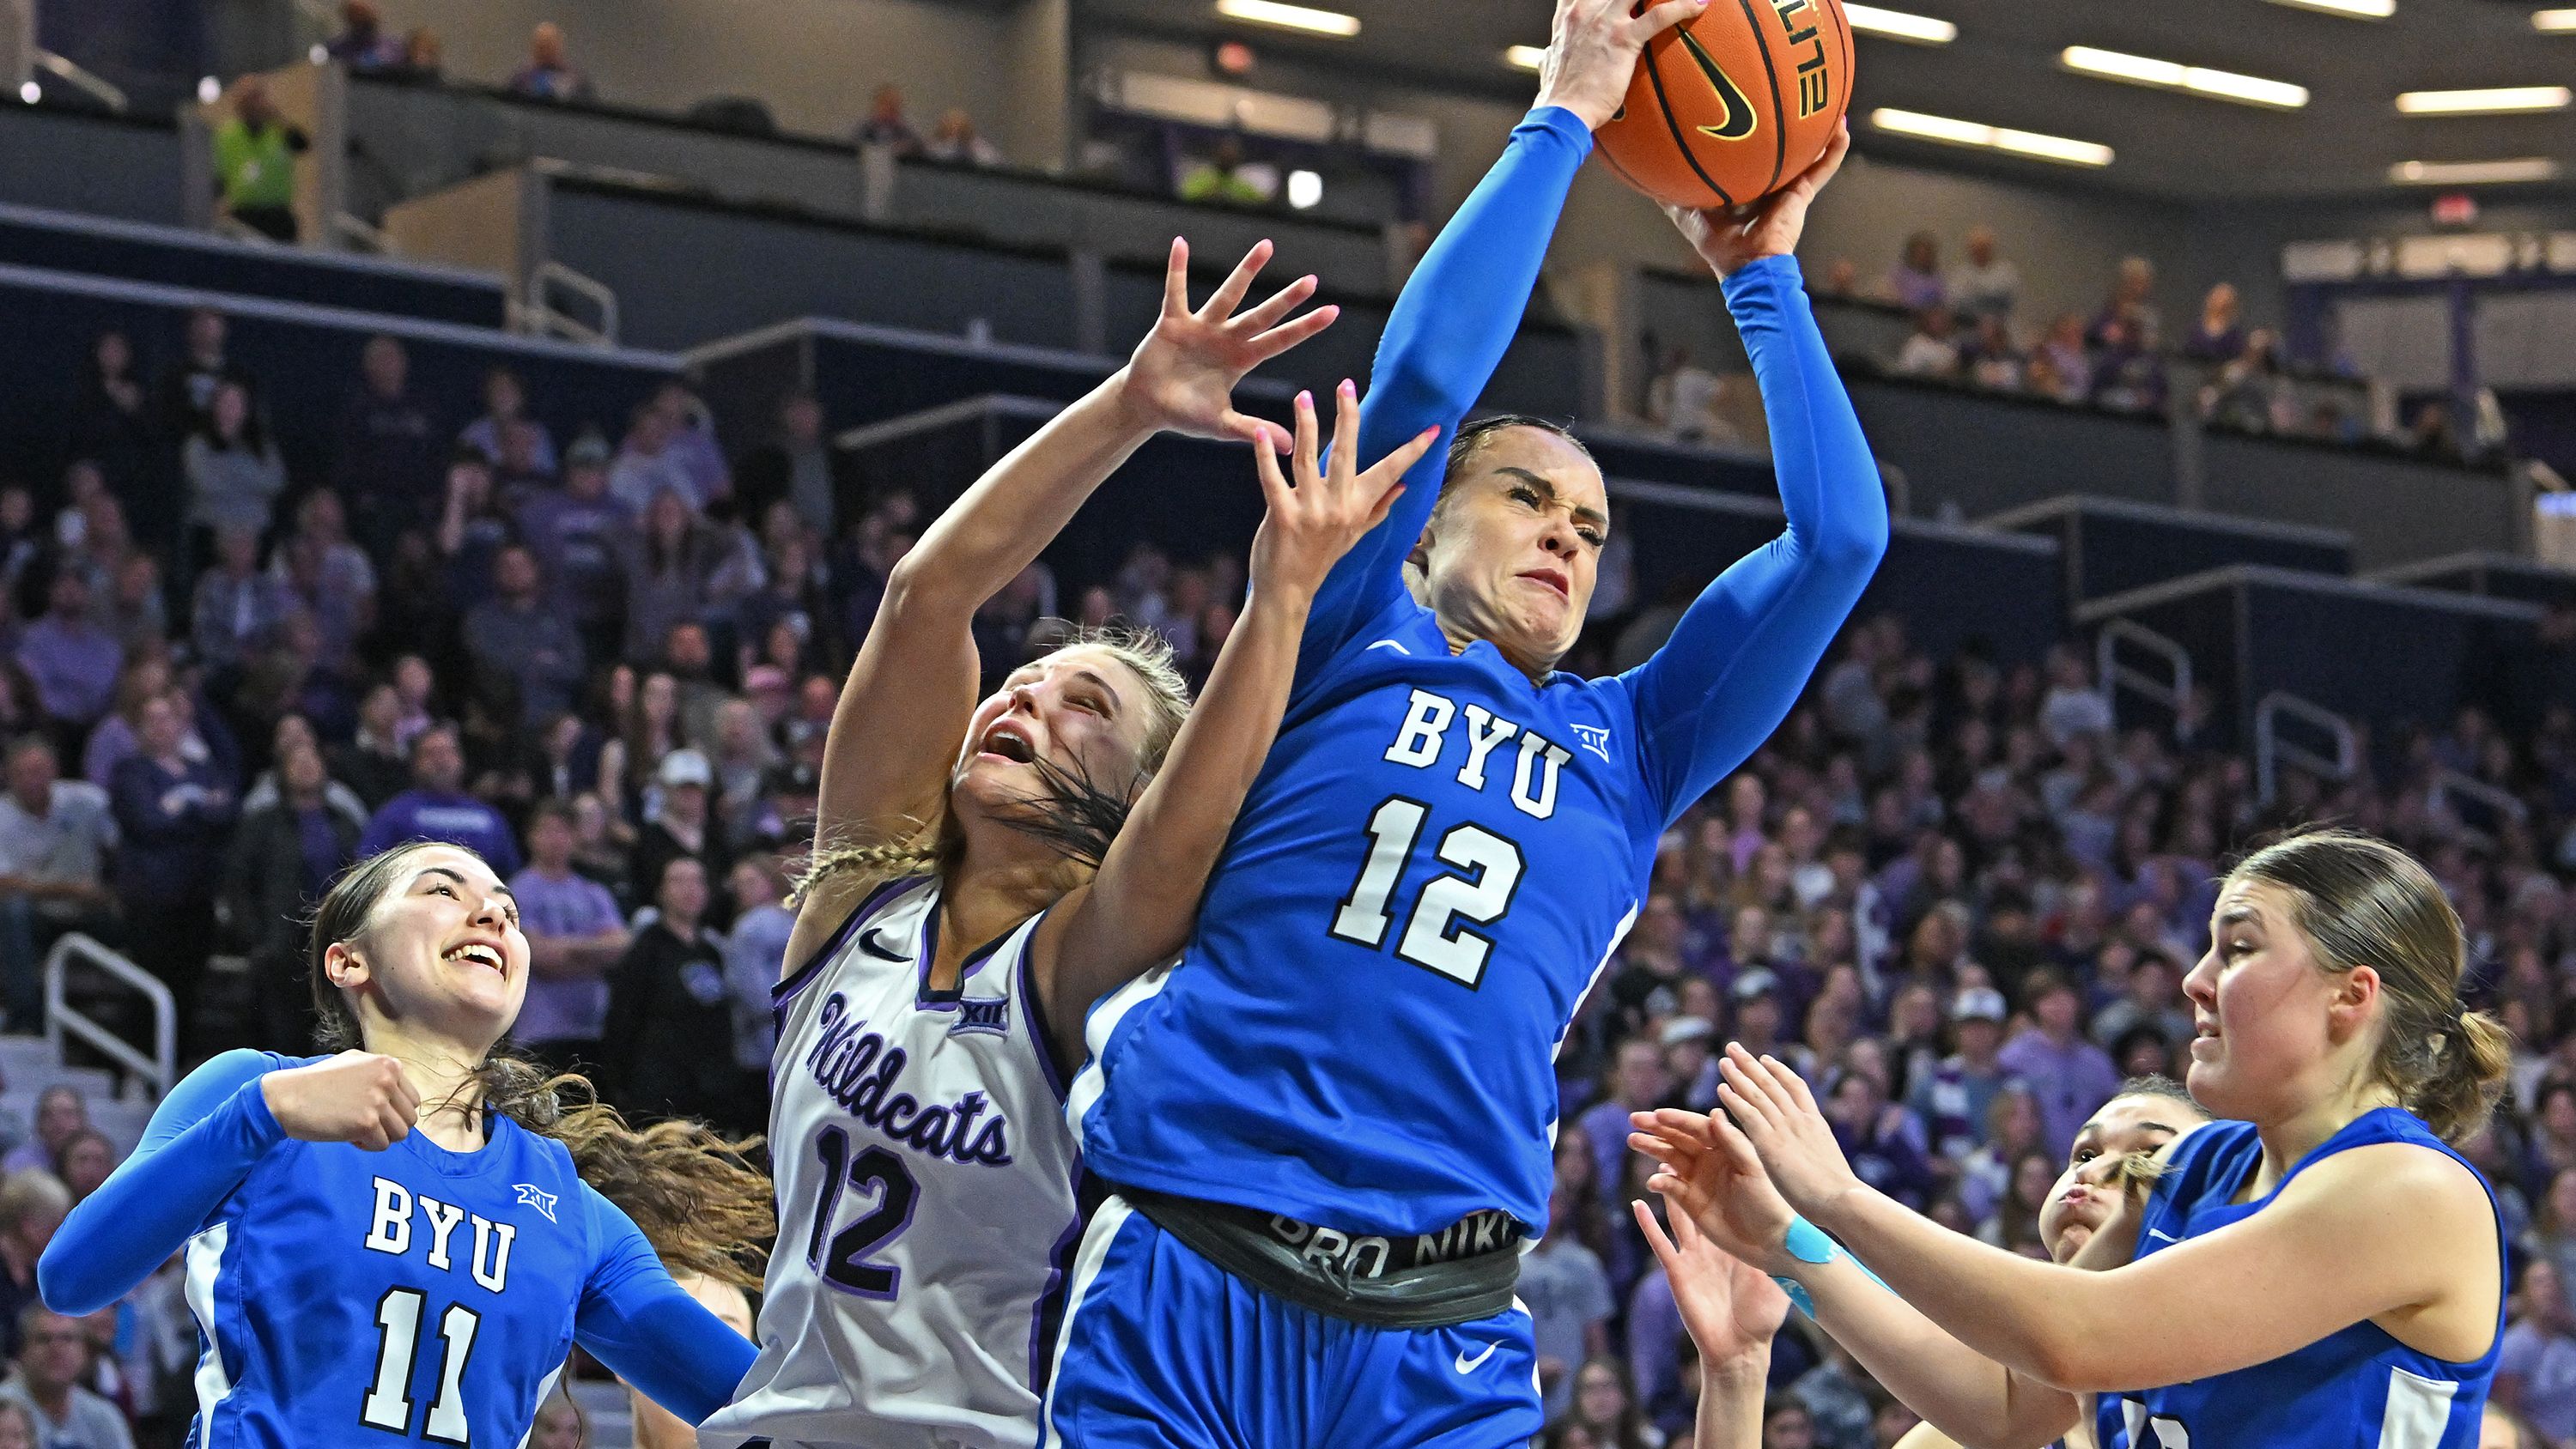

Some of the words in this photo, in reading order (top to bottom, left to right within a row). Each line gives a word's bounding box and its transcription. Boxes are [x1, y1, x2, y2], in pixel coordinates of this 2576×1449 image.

[1771, 0, 1828, 118] ELIT
[1383, 688, 1574, 821] BYU
[1327, 792, 1528, 991] 12
[805, 991, 1013, 1167] Wildcats
[951, 998, 1007, 1032] XII
[363, 1174, 516, 1294] BYU
[806, 1124, 921, 1301] 12
[1415, 1211, 1510, 1266] NIK
[358, 1283, 483, 1448] 11
